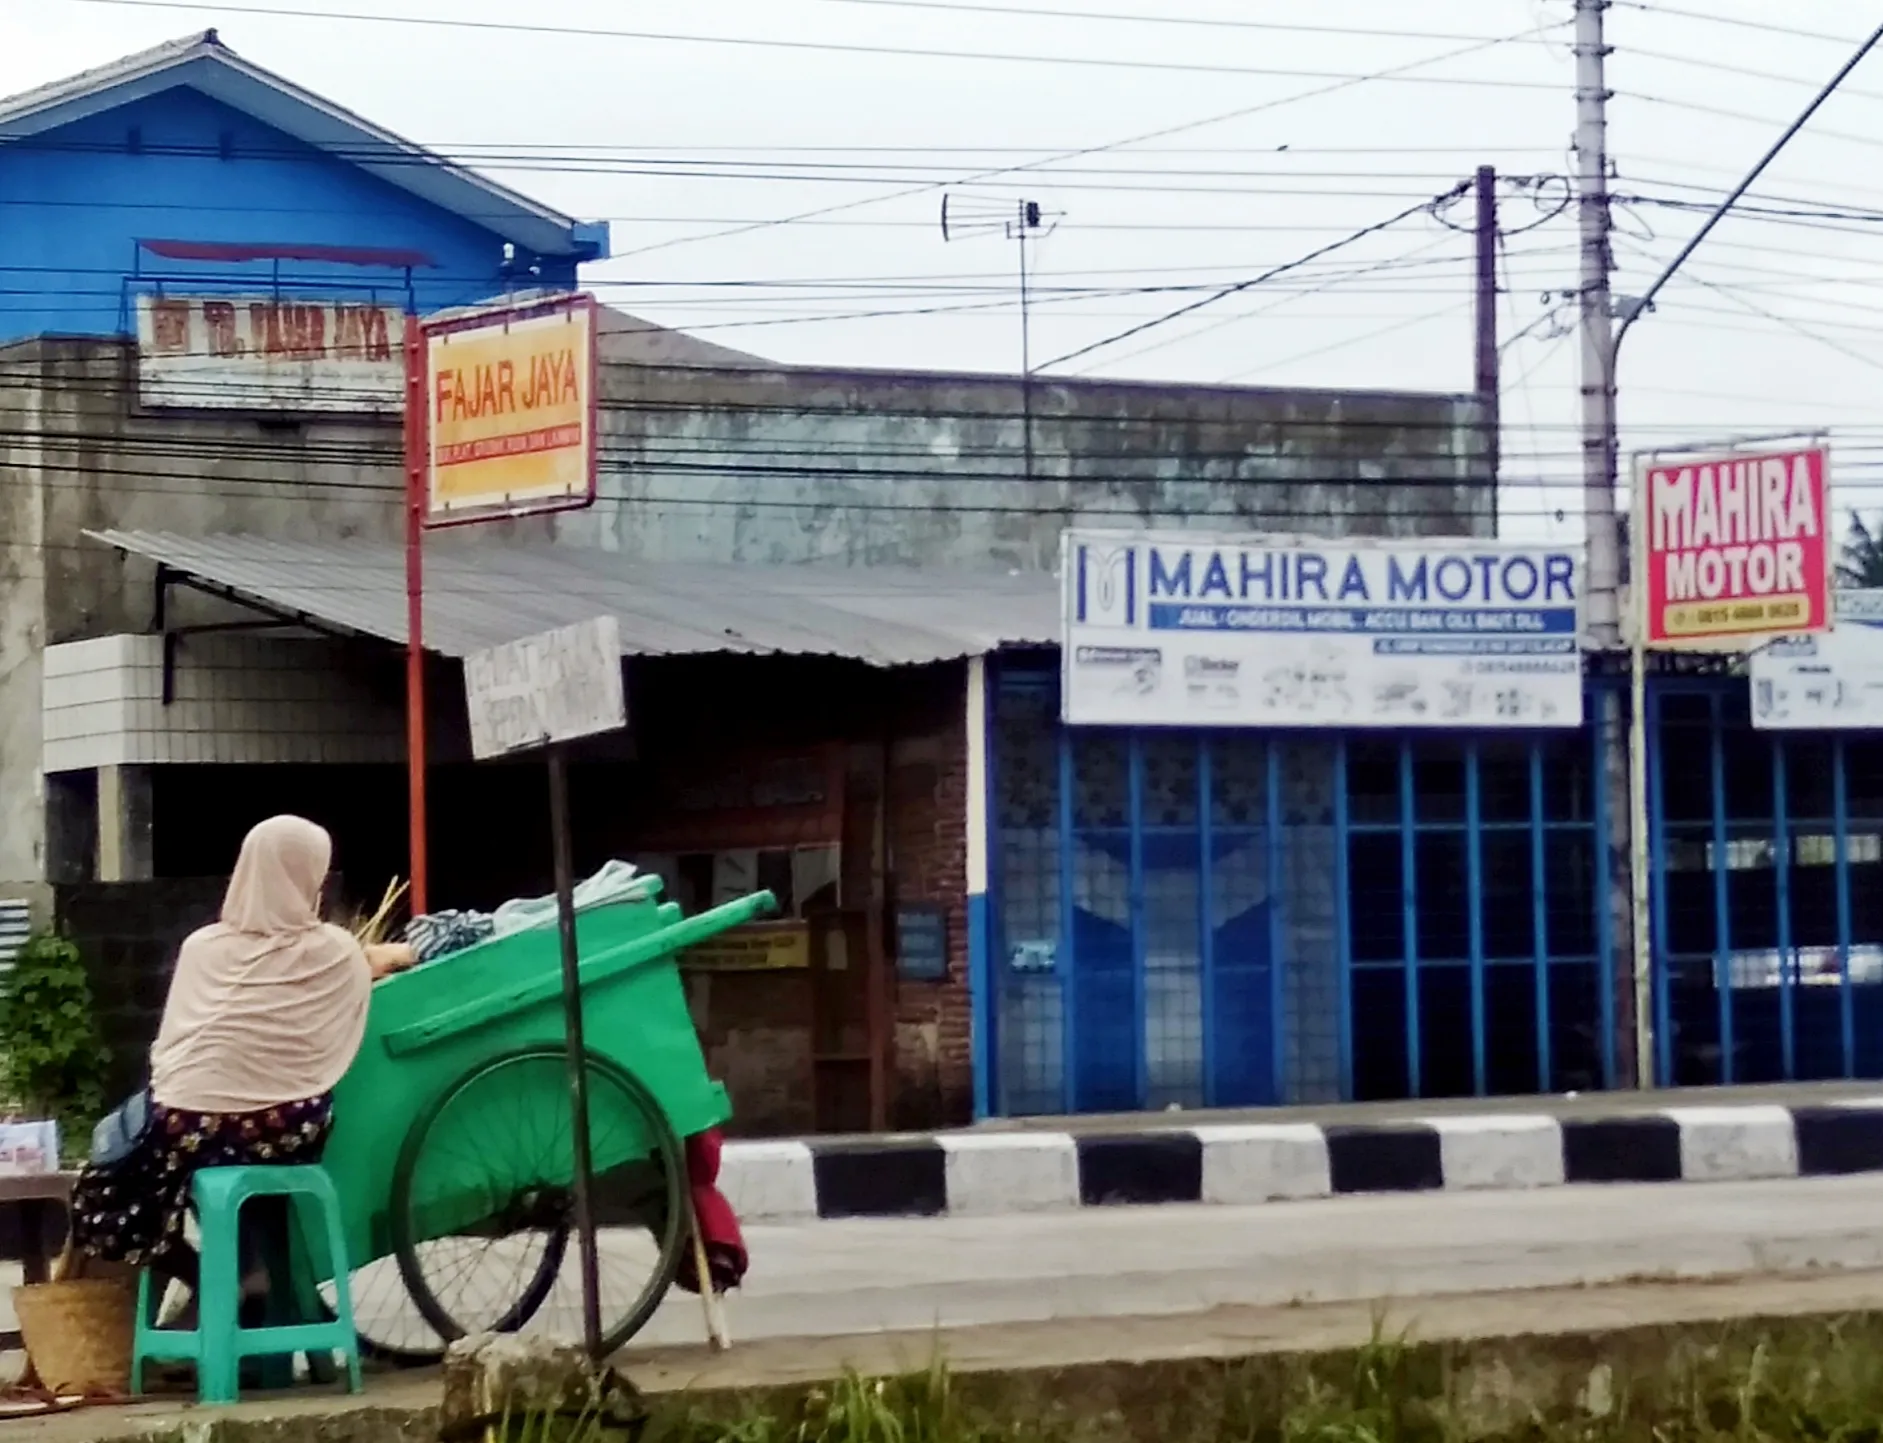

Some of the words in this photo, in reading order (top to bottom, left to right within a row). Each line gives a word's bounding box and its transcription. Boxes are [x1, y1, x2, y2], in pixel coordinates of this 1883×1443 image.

[436, 359, 516, 422] FAJAR
[521, 349, 579, 409] JAYA
[1652, 455, 1816, 550] MAHIRA
[1150, 548, 1370, 600] MAHIRA
[1388, 553, 1576, 602] MOTOR
[1666, 542, 1805, 600] MOTOR
